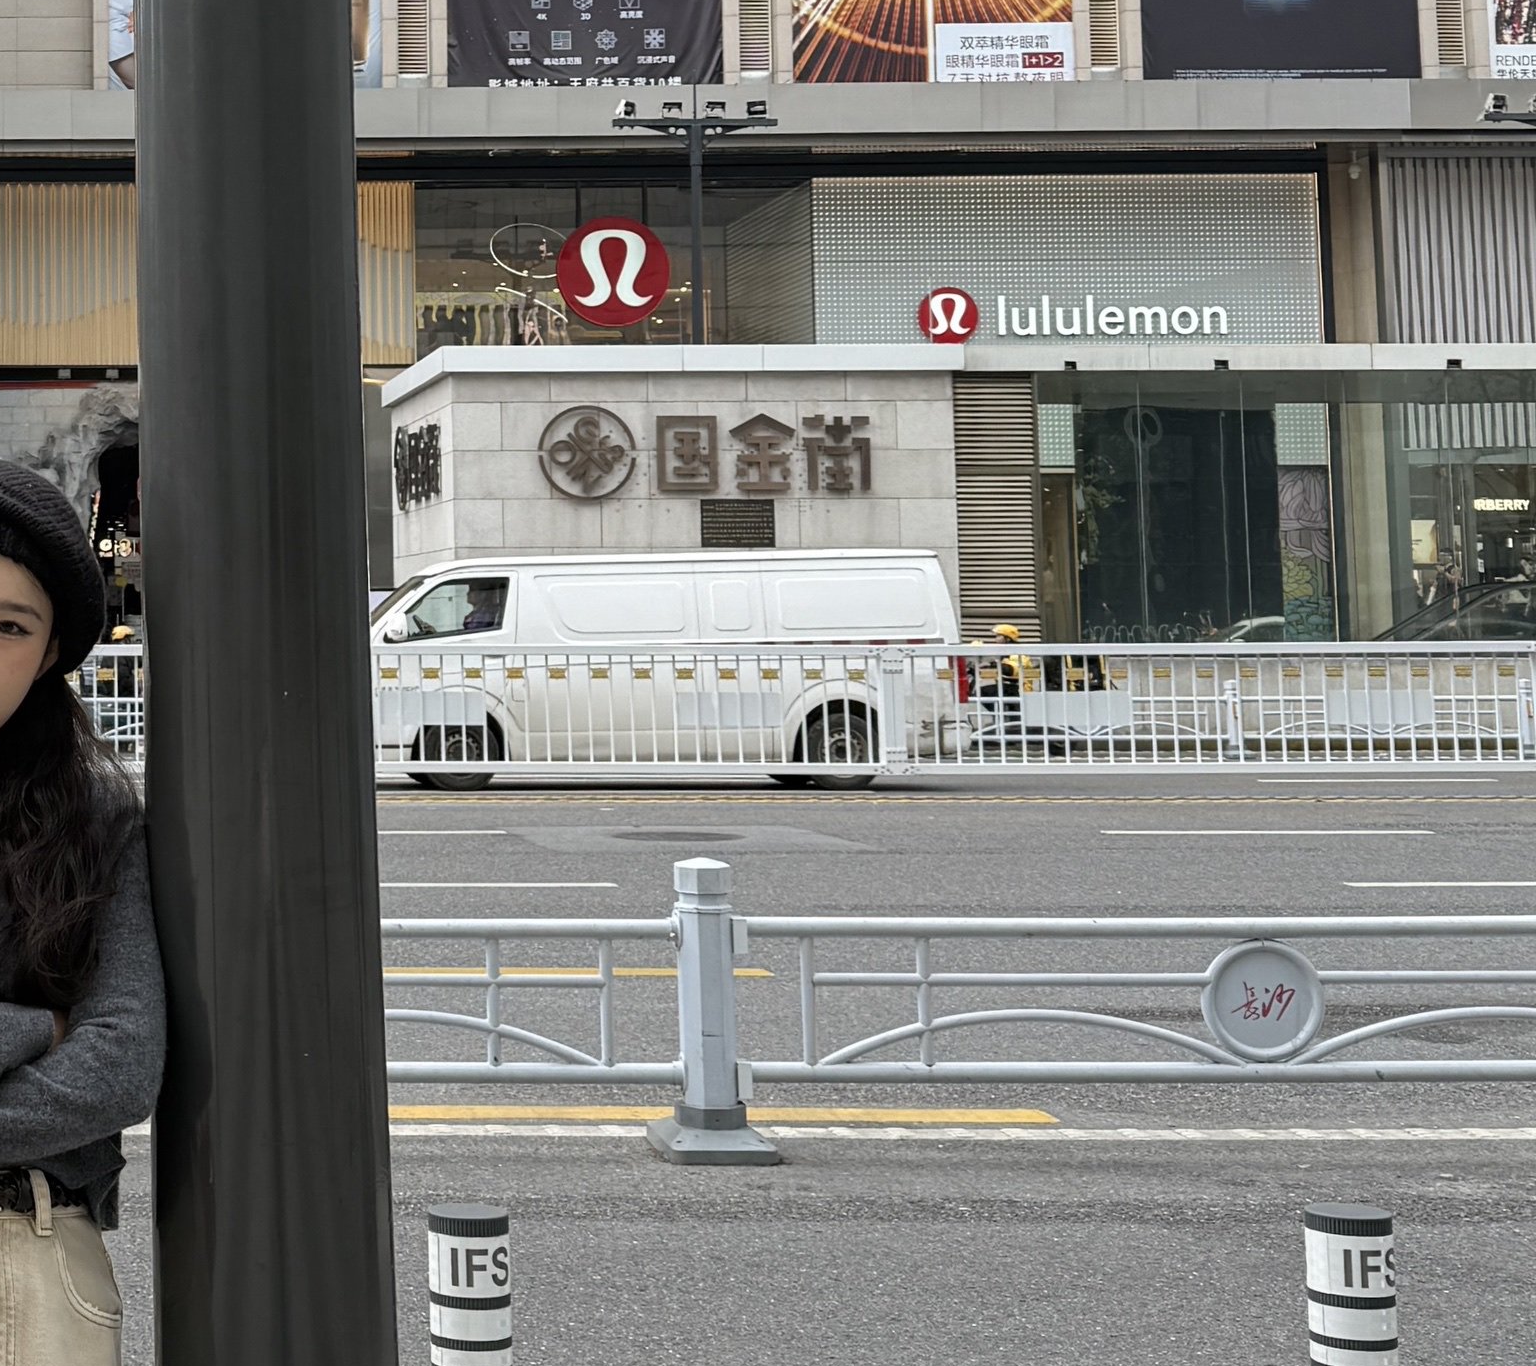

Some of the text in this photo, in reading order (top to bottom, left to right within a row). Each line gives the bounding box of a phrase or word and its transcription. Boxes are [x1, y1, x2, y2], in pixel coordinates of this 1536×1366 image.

[960, 35, 1050, 50] 双萃精华眼霜
[1024, 54, 1063, 67] 1+1>2
[998, 295, 1228, 336] lululemon
[656, 413, 871, 493] 国金街
[450, 1246, 509, 1288] IFS
[1343, 1247, 1396, 1289] IFS
